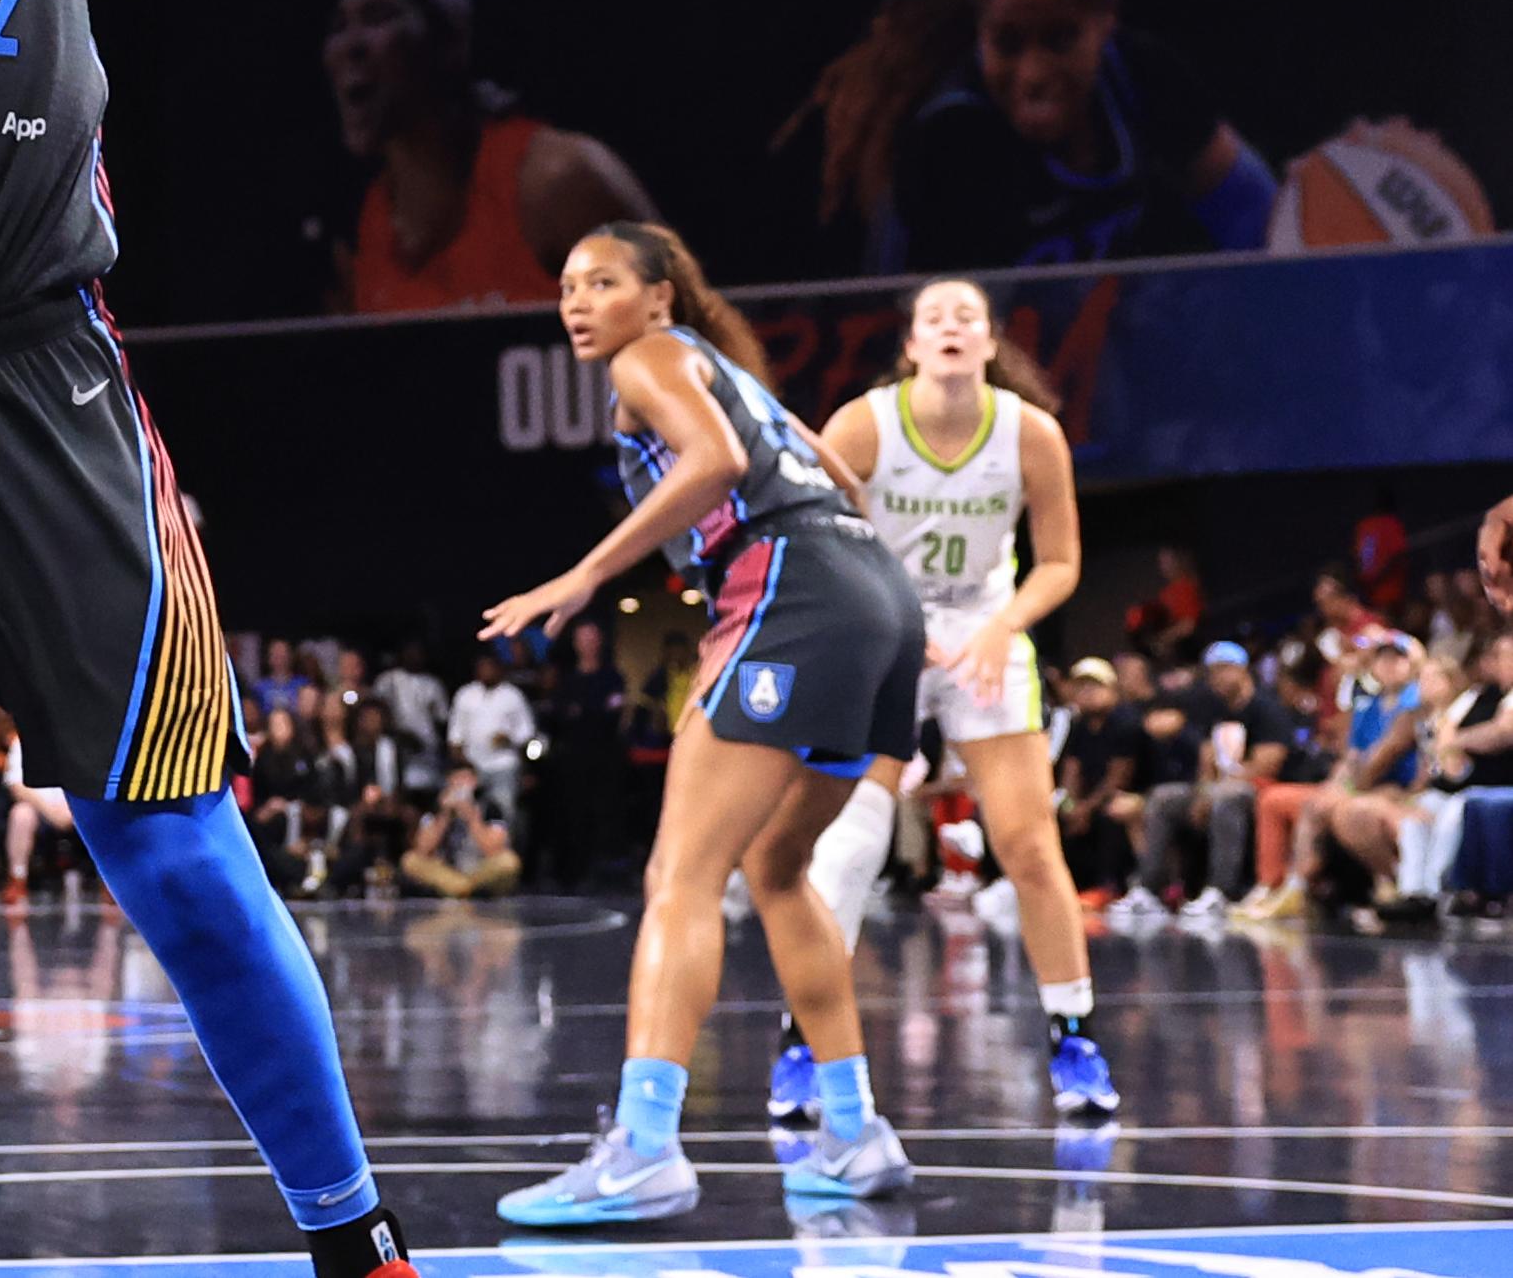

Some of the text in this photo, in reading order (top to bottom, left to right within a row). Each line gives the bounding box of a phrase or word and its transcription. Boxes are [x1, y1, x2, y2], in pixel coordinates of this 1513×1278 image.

[1, 115, 46, 141] App
[498, 344, 614, 449] OU
[922, 530, 967, 577] 20
